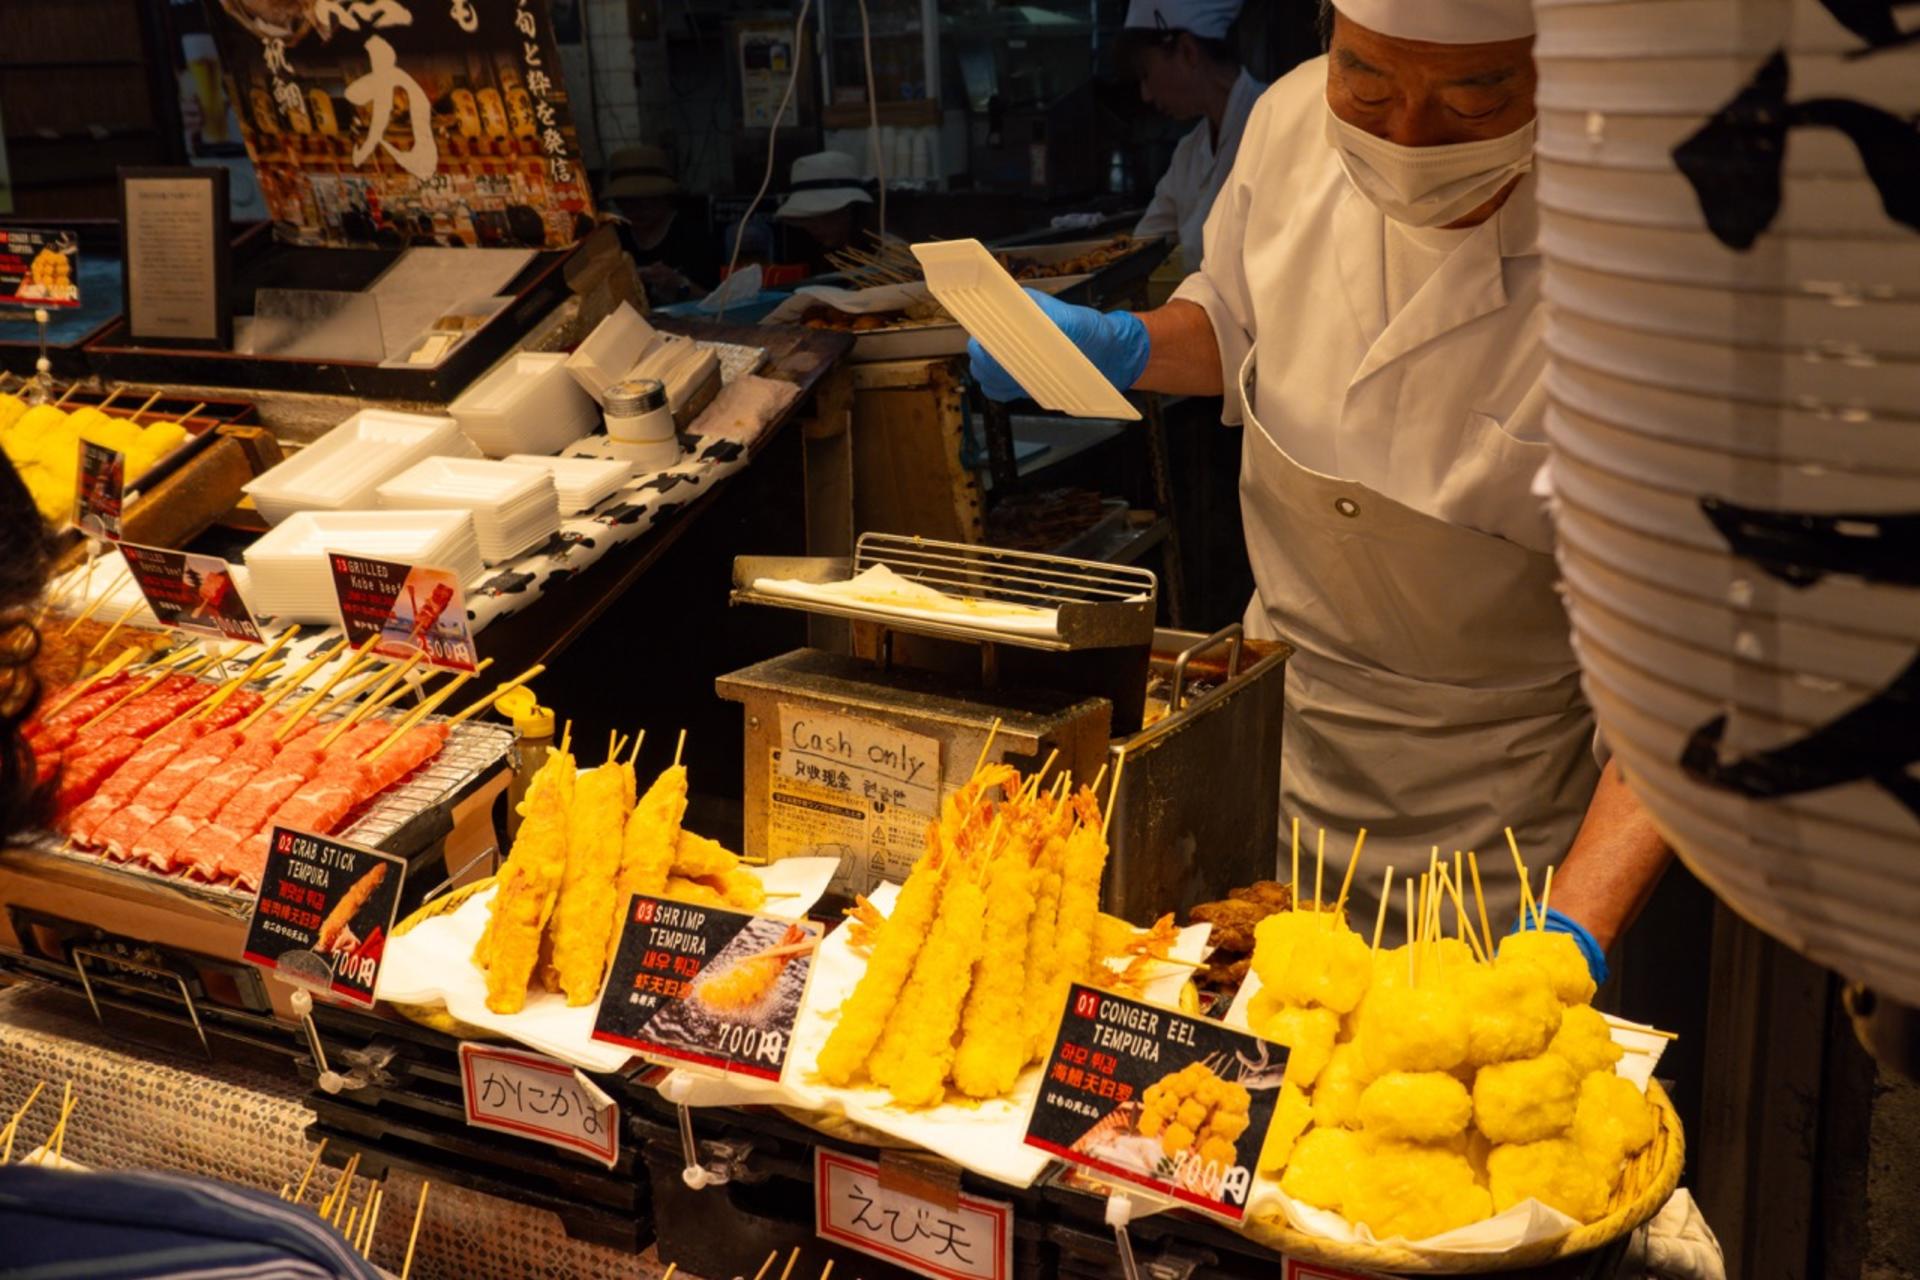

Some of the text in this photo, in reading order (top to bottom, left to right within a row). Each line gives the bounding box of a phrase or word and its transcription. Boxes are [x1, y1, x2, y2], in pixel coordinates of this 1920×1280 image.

[514, 0, 571, 183] 旬と粋を発信
[348, 560, 388, 578] GRILLED
[791, 720, 852, 758] Cash
[794, 759, 852, 791] 只收现金
[279, 835, 357, 872] 02 CRAB STICK
[287, 860, 330, 888] TEMPURA
[637, 901, 706, 930] 03 SHRIMP
[649, 927, 707, 955] TEMPURA
[332, 949, 377, 988] 700円
[1077, 993, 1197, 1047] 01 CONGER EEL
[718, 1023, 784, 1064] 700円
[1091, 1024, 1161, 1063] TEMPURA
[1173, 1149, 1251, 1205] 700円
[848, 1183, 974, 1265] えび天
